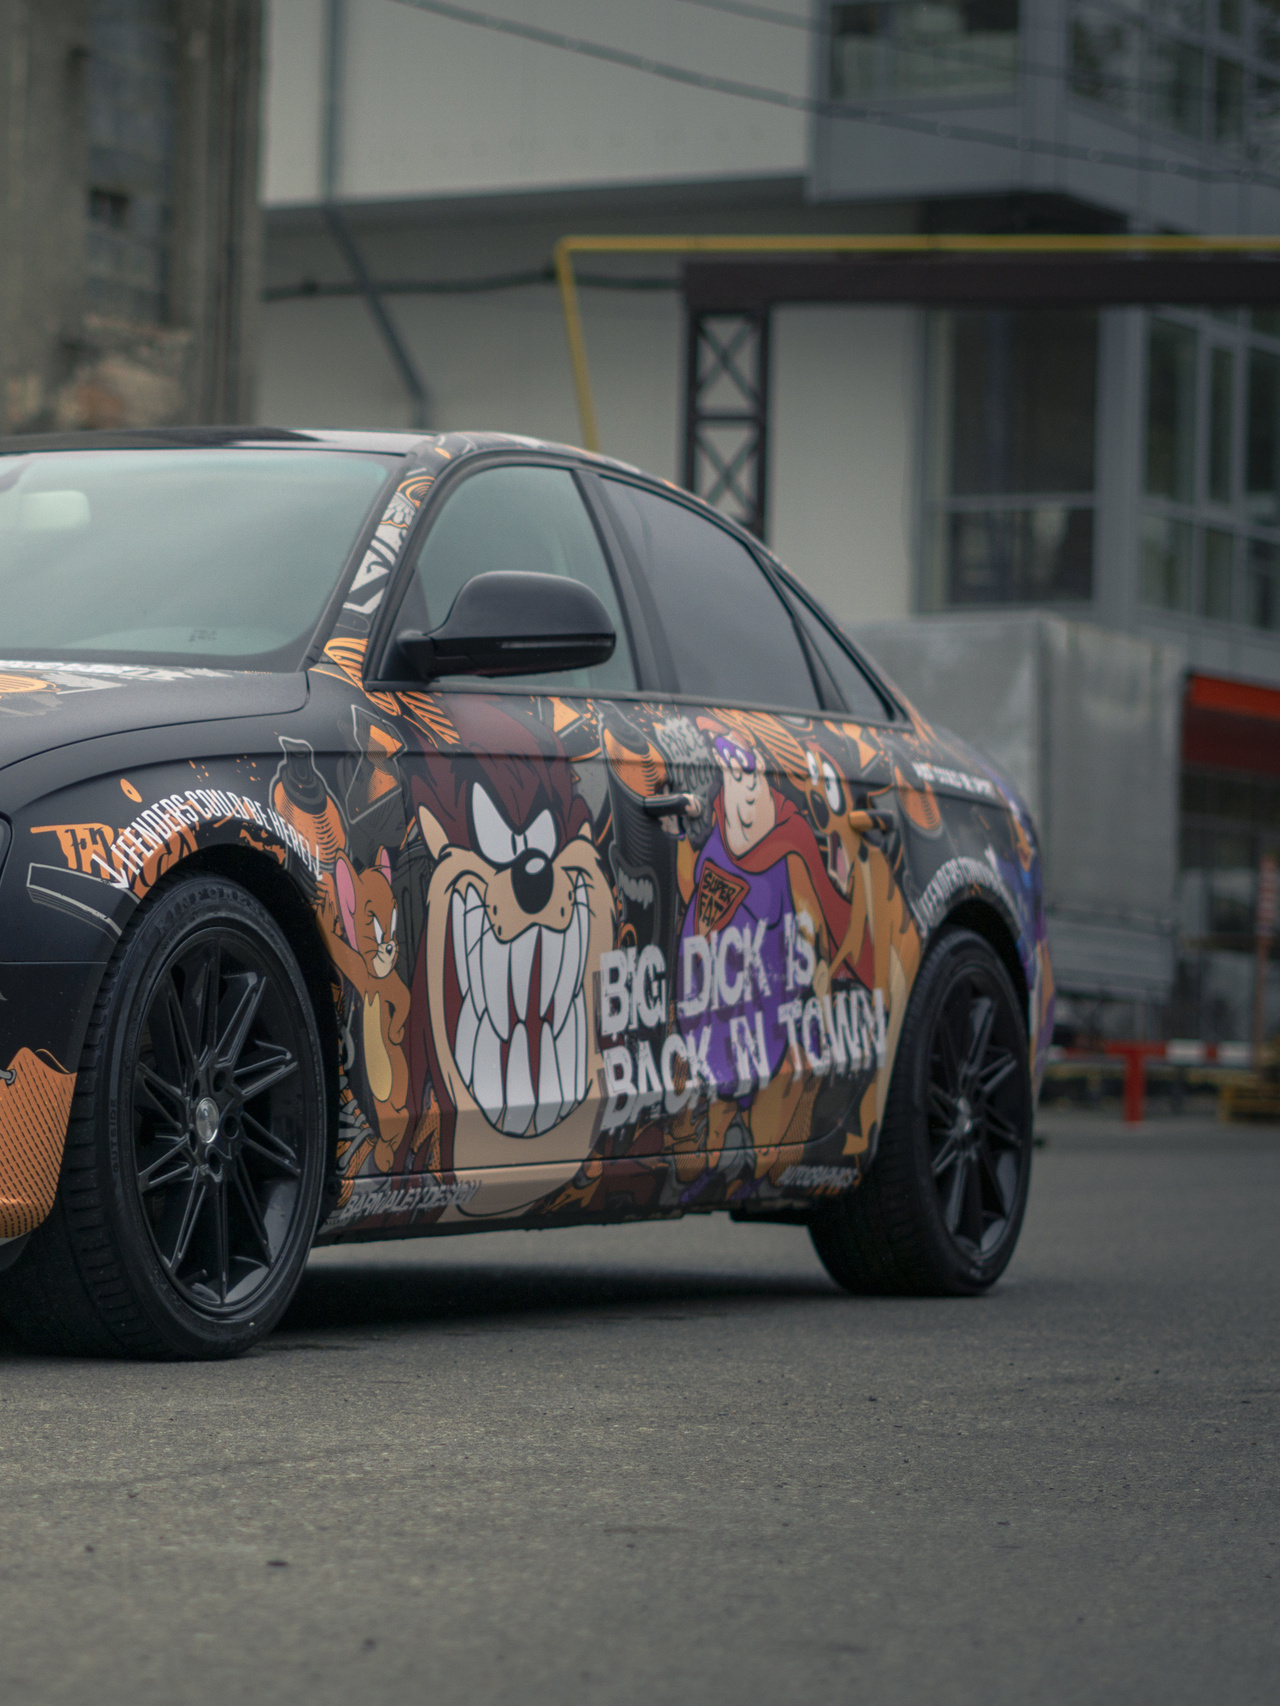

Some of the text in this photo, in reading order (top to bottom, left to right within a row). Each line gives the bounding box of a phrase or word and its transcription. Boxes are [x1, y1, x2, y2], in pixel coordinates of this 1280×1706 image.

[184, 789, 250, 820] COULD
[242, 796, 272, 831] BE
[699, 891, 725, 926] FAT
[702, 871, 737, 904] SUPER
[600, 911, 816, 1039] BIG DICK IS
[600, 988, 888, 1132] BACK IN TOWN
